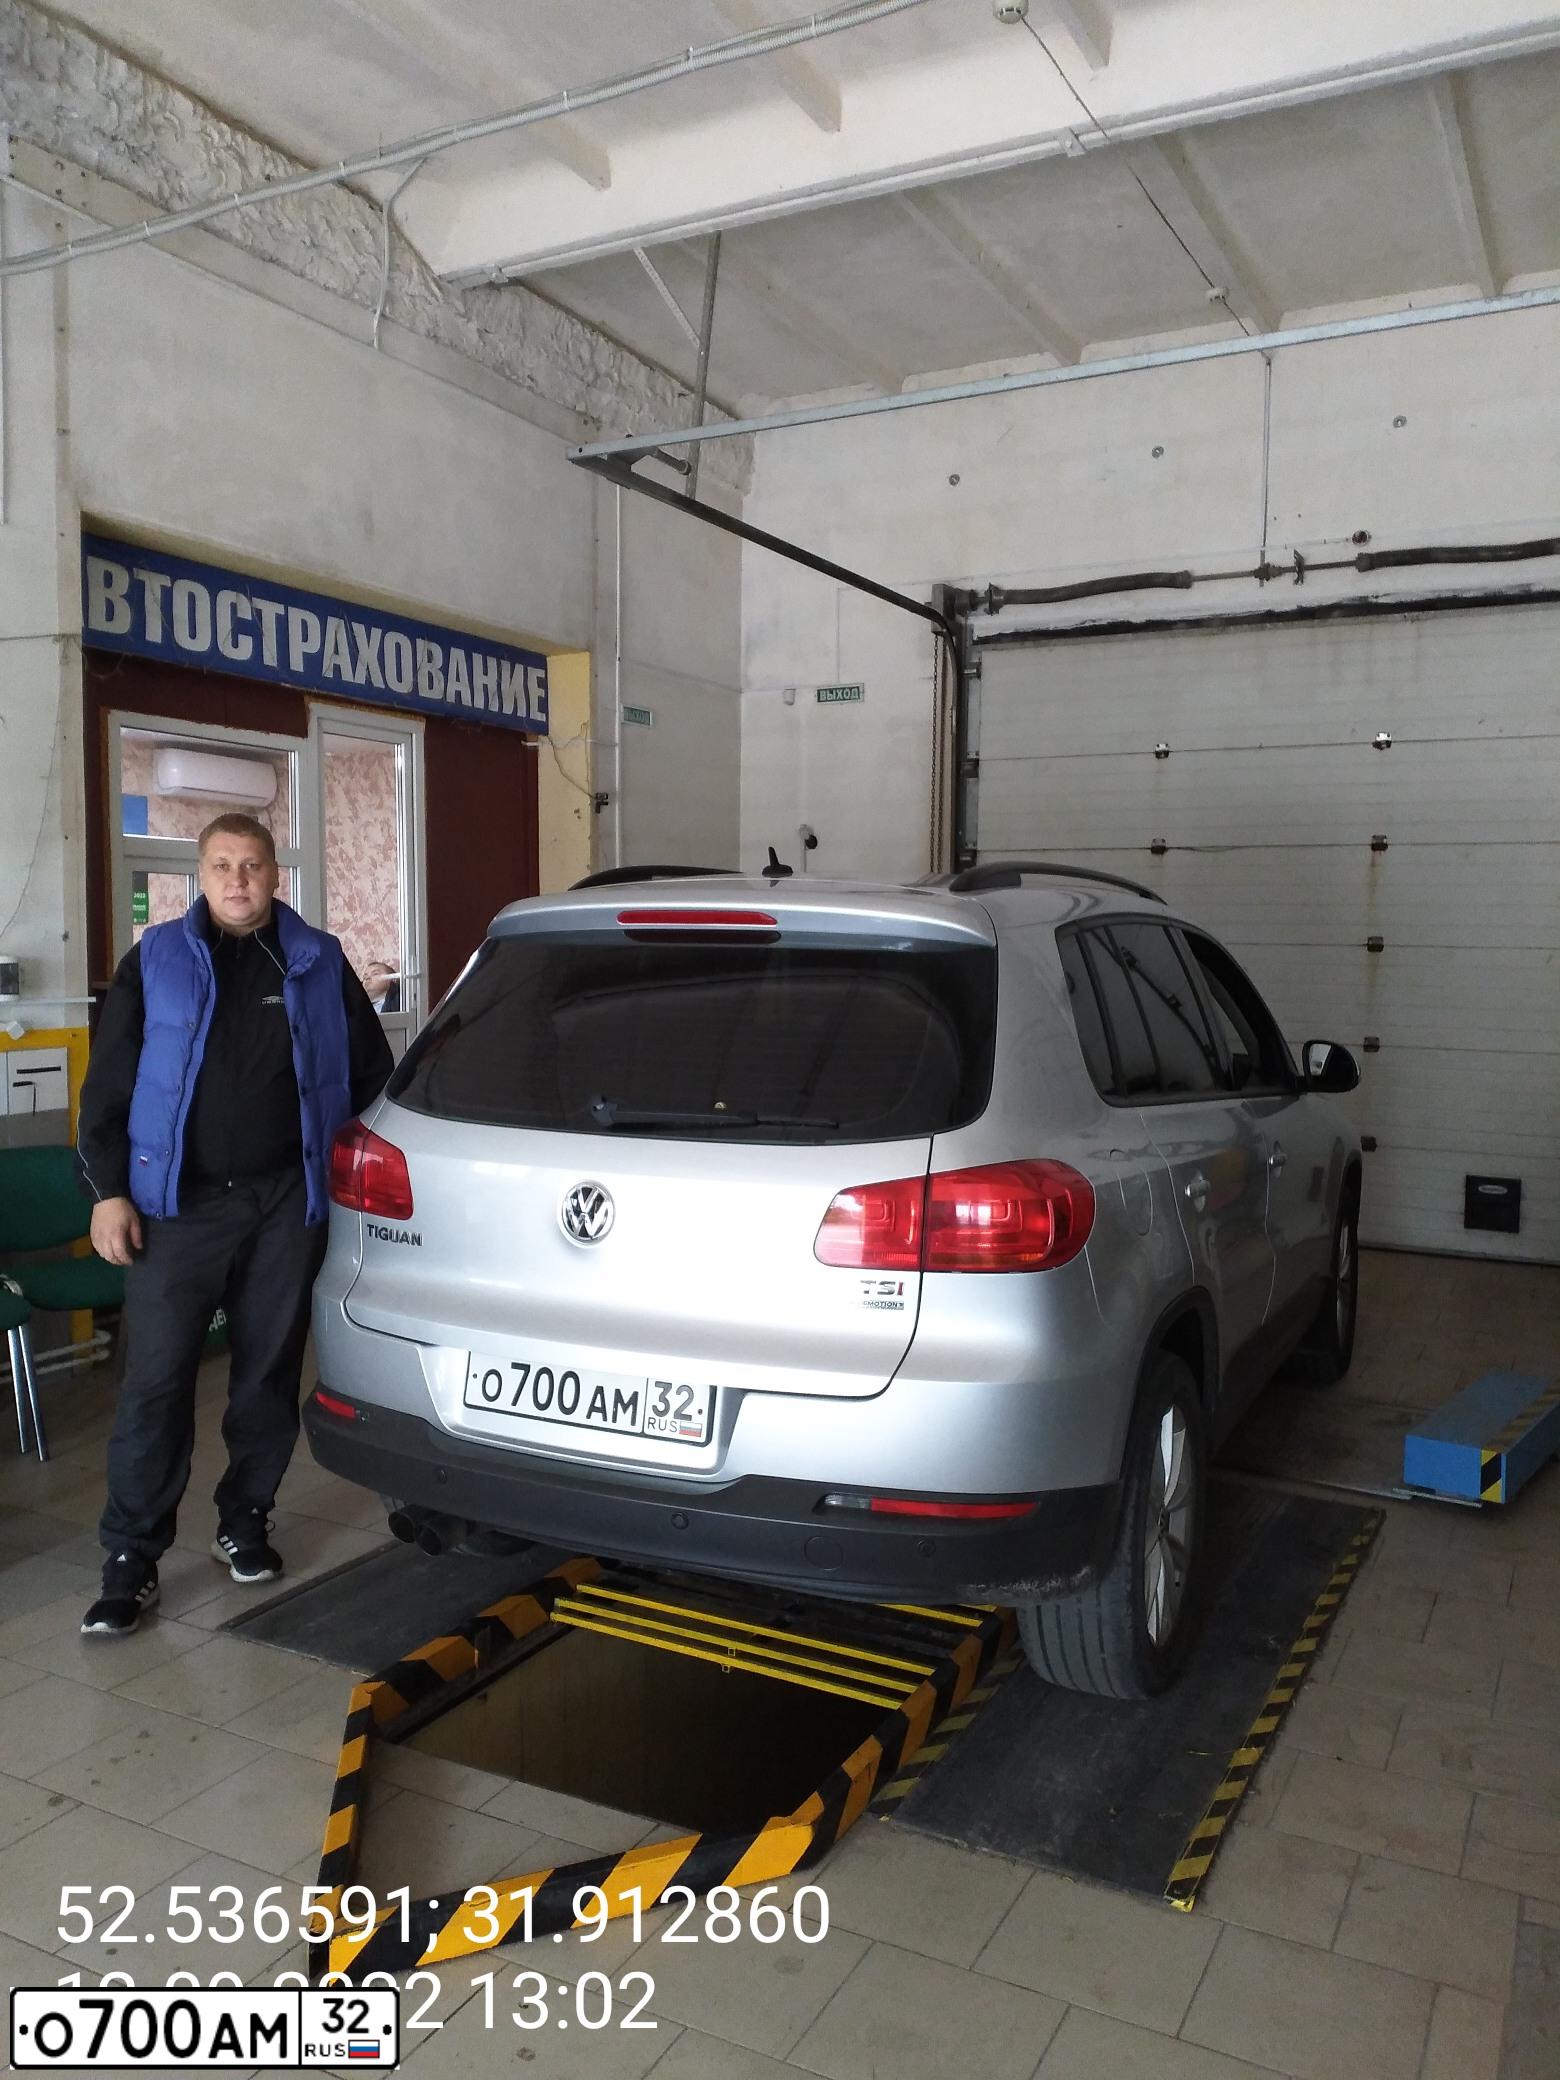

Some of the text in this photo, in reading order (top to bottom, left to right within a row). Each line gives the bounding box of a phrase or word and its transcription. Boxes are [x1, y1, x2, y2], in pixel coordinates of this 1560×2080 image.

[82, 555, 547, 722] ВТОСТРАХОВАНИЕ
[819, 687, 859, 701] ВЫХОД
[367, 1223, 423, 1247] TIGUAN
[860, 1280, 904, 1296] TSI
[651, 1381, 695, 1422] 32
[647, 1417, 678, 1433] RUS
